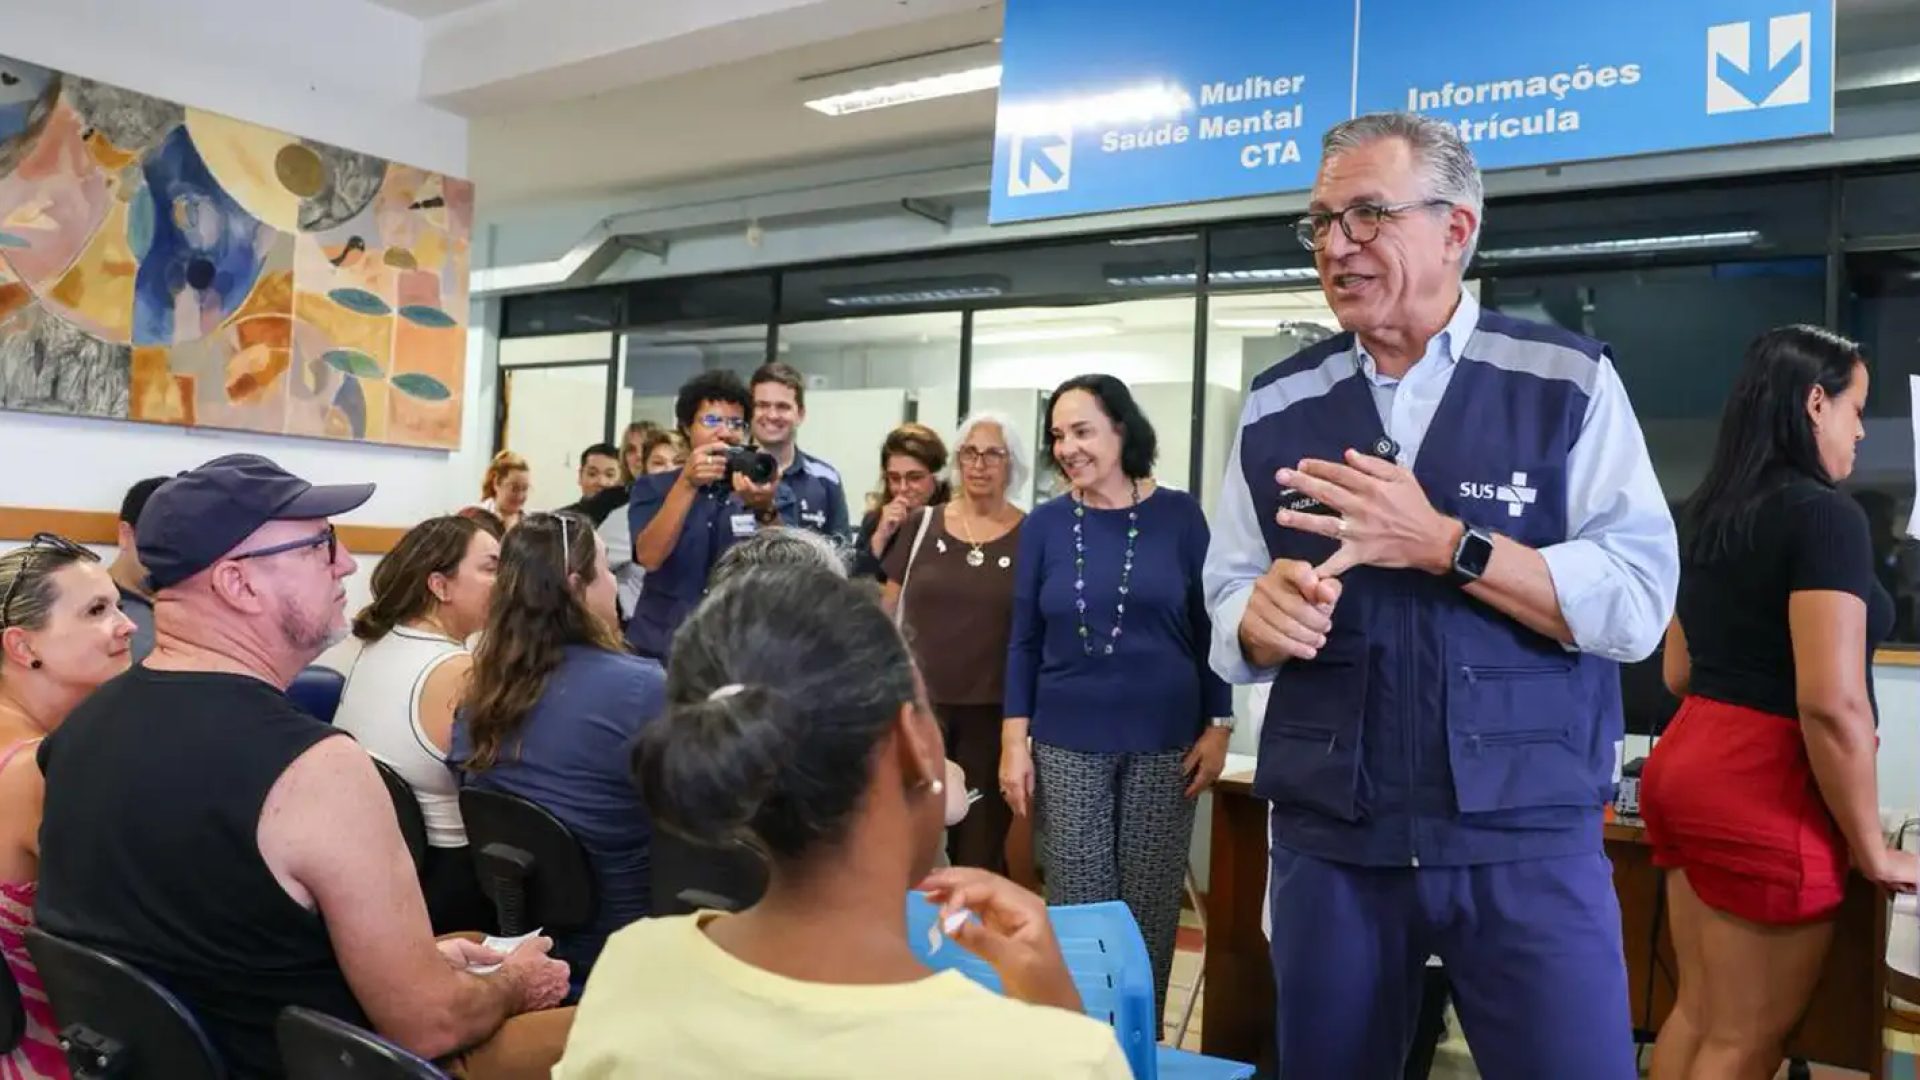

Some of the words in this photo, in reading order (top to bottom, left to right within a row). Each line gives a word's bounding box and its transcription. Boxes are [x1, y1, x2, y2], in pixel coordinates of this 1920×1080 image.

[1201, 75, 1304, 106] Mulher
[1408, 61, 1641, 112] Informações
[1102, 122, 1189, 152] Saúde
[1199, 104, 1302, 140] Mental
[1422, 108, 1580, 144] trícula
[1240, 140, 1301, 168] CTA
[1460, 481, 1494, 499] SUS
